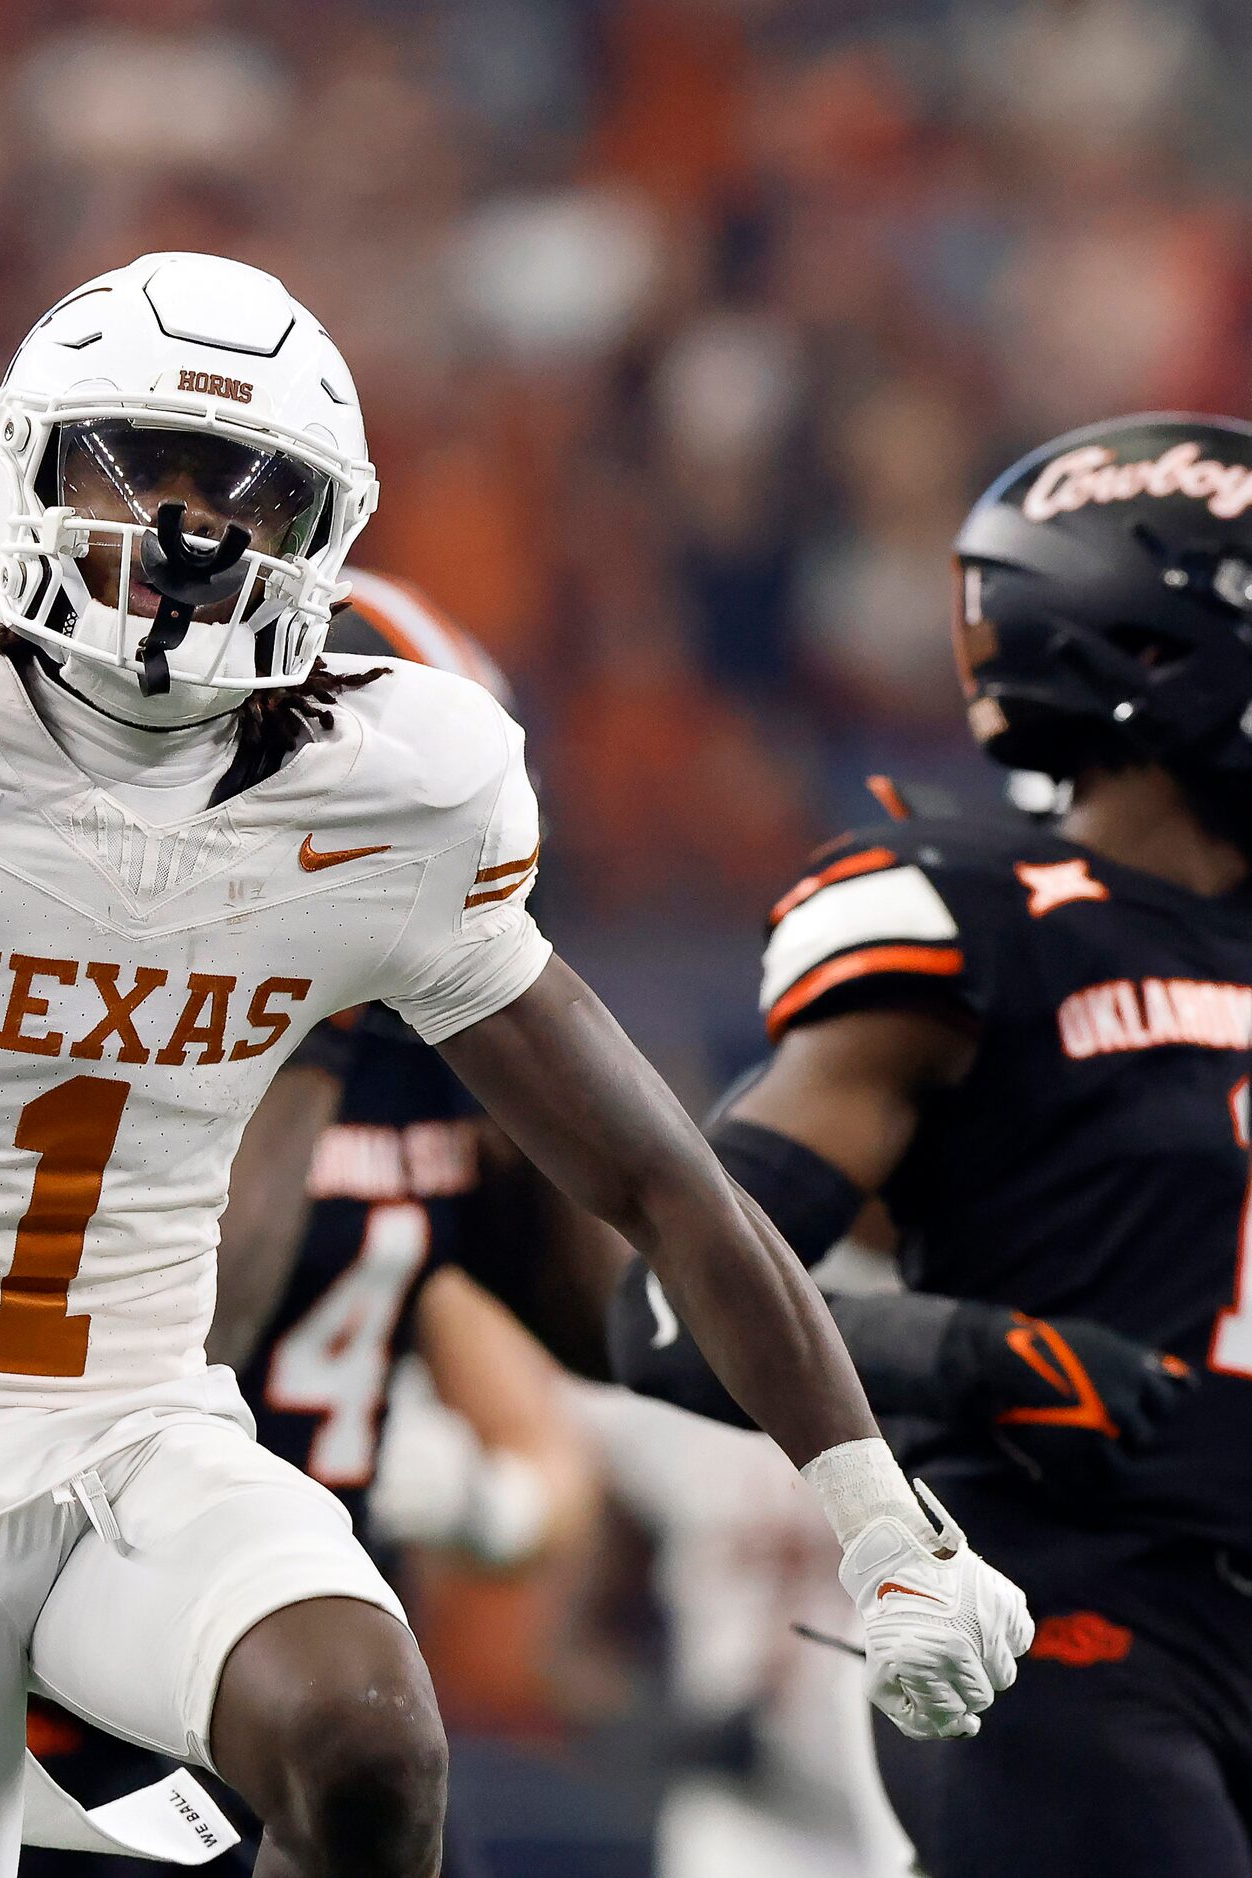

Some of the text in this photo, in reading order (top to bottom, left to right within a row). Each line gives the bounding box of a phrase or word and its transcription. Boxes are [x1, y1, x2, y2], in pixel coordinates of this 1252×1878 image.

[177, 370, 254, 404] HORNS
[263, 1200, 432, 1488] 4
[169, 1789, 218, 1848] WE BALL.
